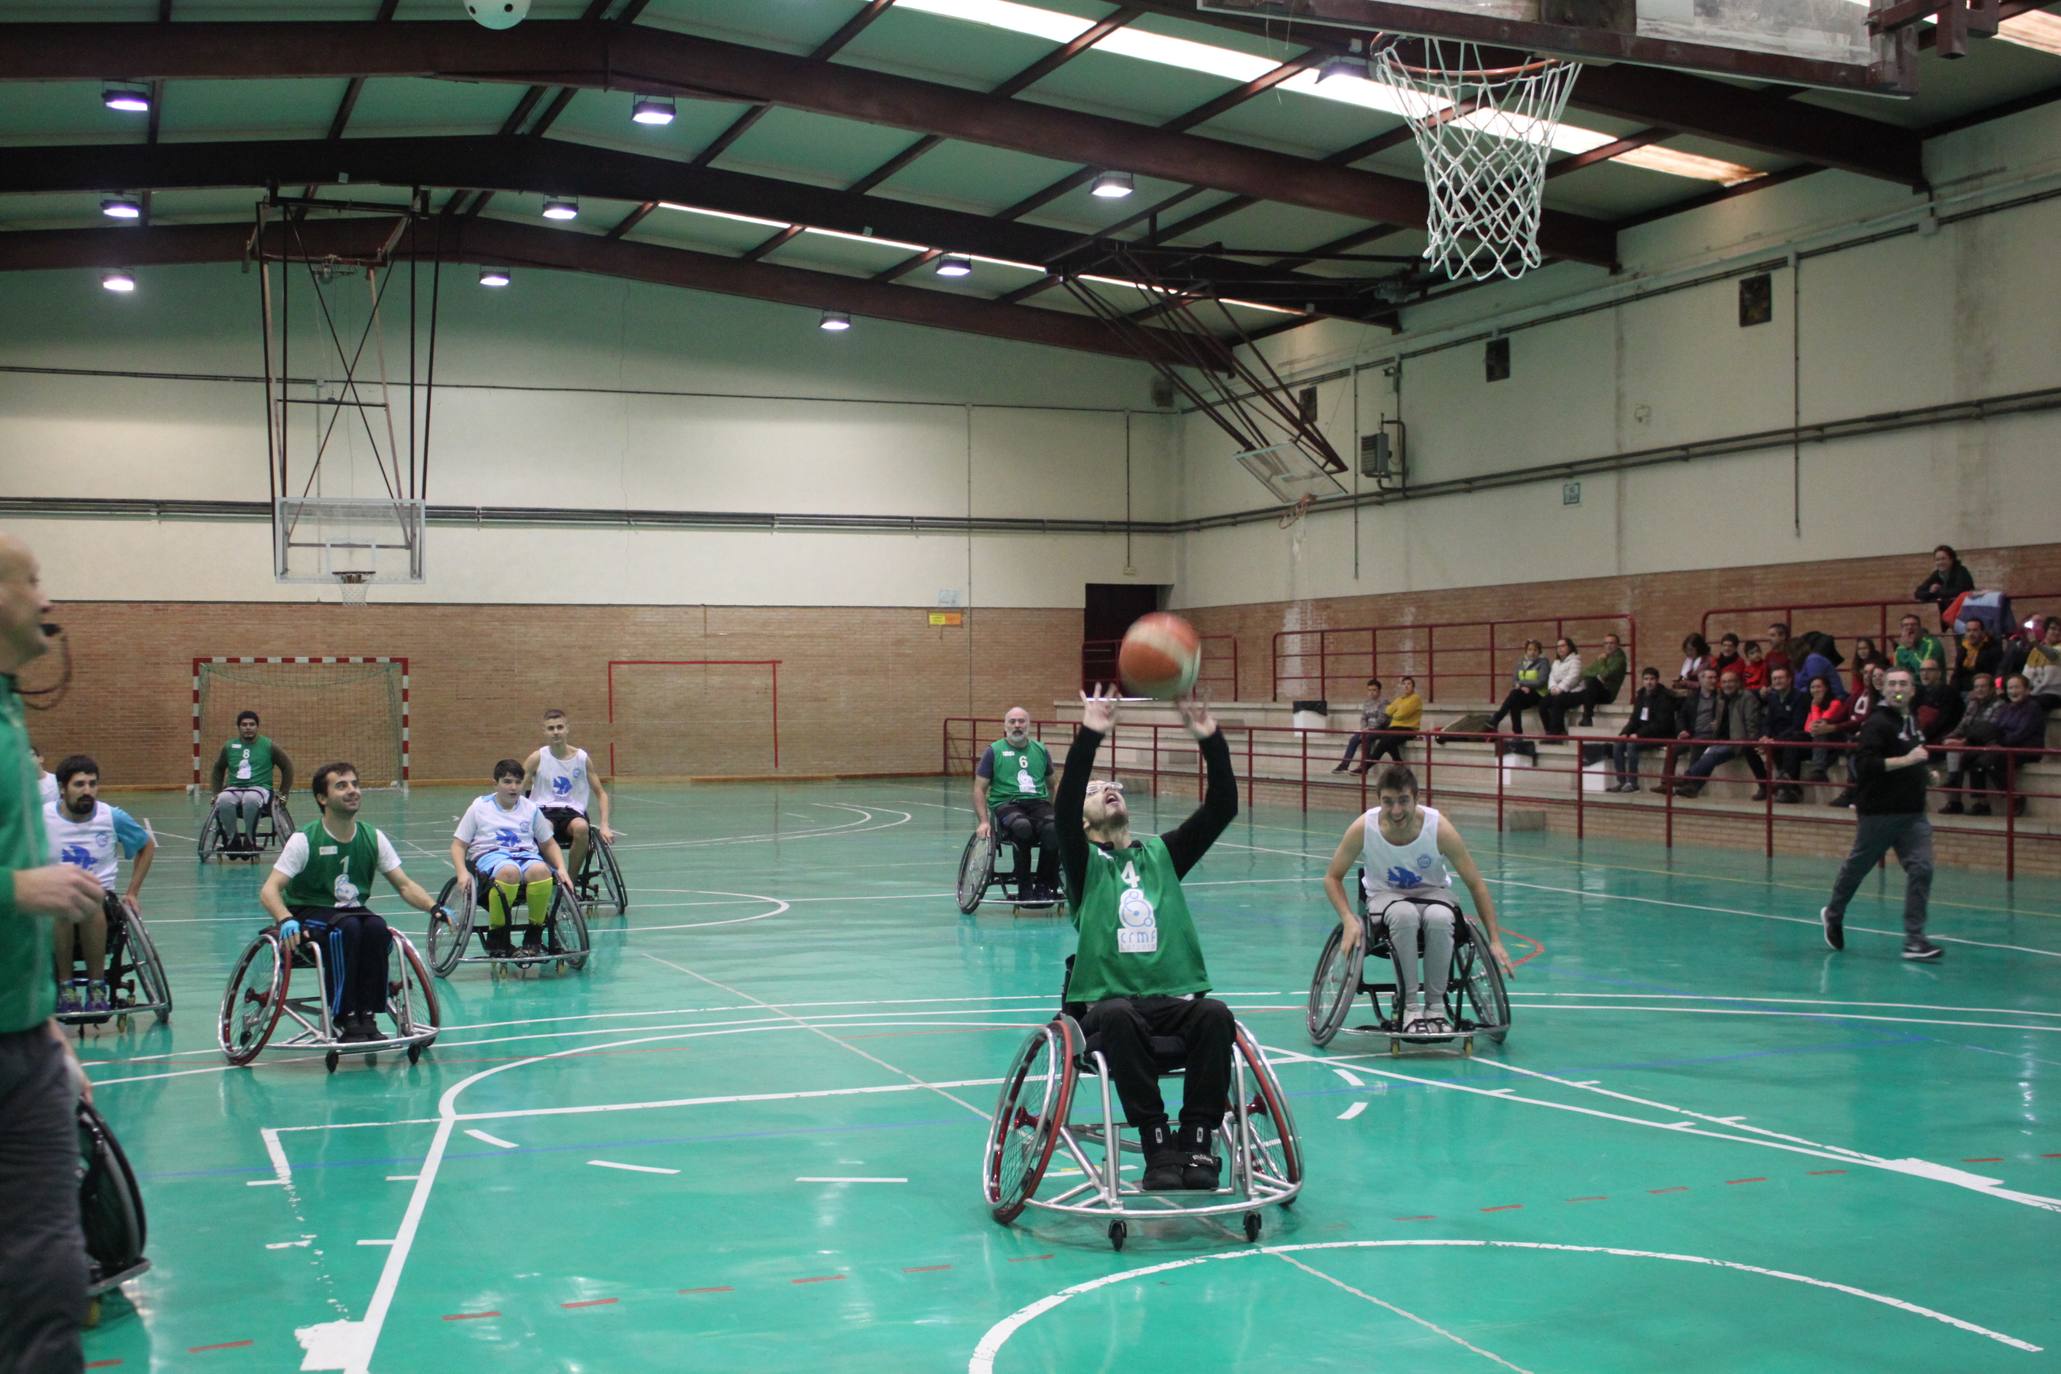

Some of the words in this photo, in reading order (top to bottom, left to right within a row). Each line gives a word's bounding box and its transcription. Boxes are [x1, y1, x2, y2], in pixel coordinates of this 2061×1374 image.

[243, 748, 250, 759] 8
[1019, 755, 1029, 769] 6
[340, 856, 349, 874] 1
[1120, 860, 1140, 888] 4
